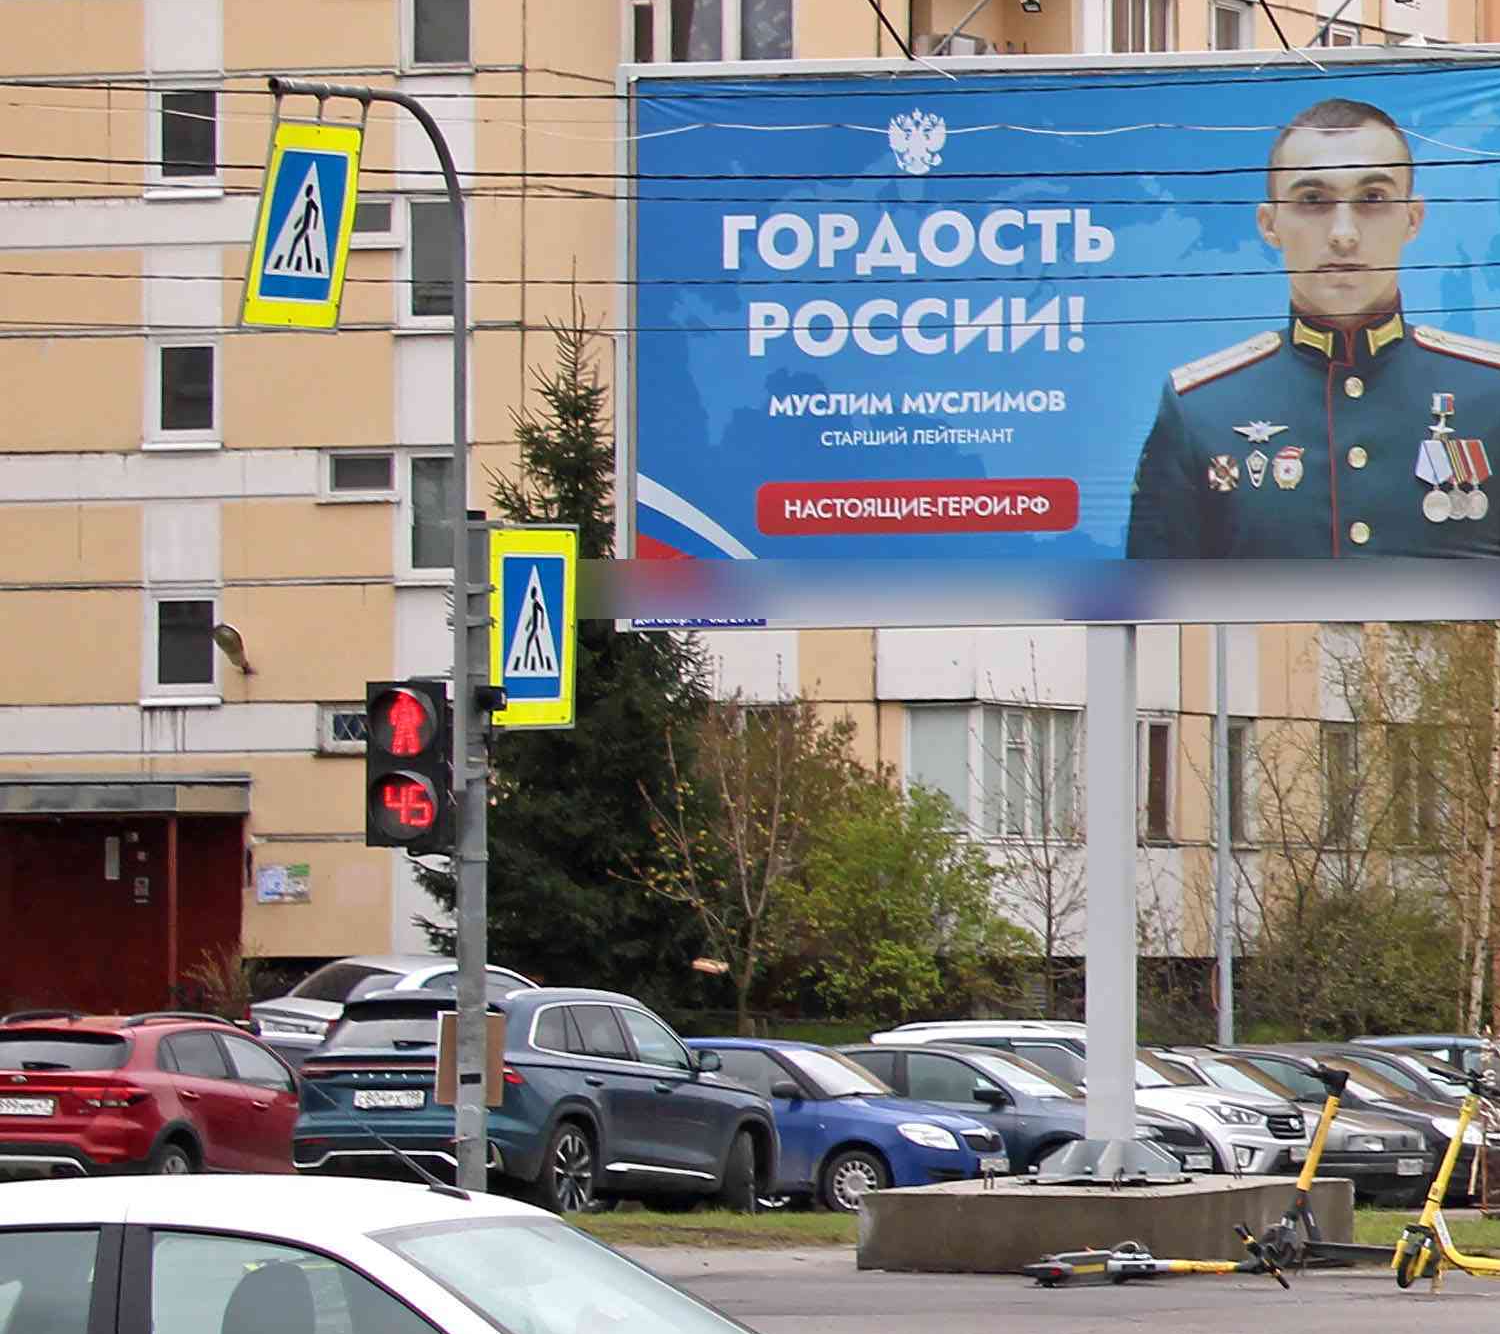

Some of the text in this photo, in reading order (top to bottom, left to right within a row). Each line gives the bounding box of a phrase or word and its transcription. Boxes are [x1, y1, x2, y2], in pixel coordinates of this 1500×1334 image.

[722, 207, 1116, 275] ГОРДОСТЬ
[747, 295, 1086, 357] РОССИИ!
[768, 388, 1067, 417] МУСЛИМ МУСЛИМОВ
[820, 425, 1014, 447] СТАРШИЙ ЛЕЙТЕНАНТ
[783, 494, 1051, 522] НАСТОЯЩИЕ-ГЕРОИ.РФ
[383, 782, 433, 828] 45
